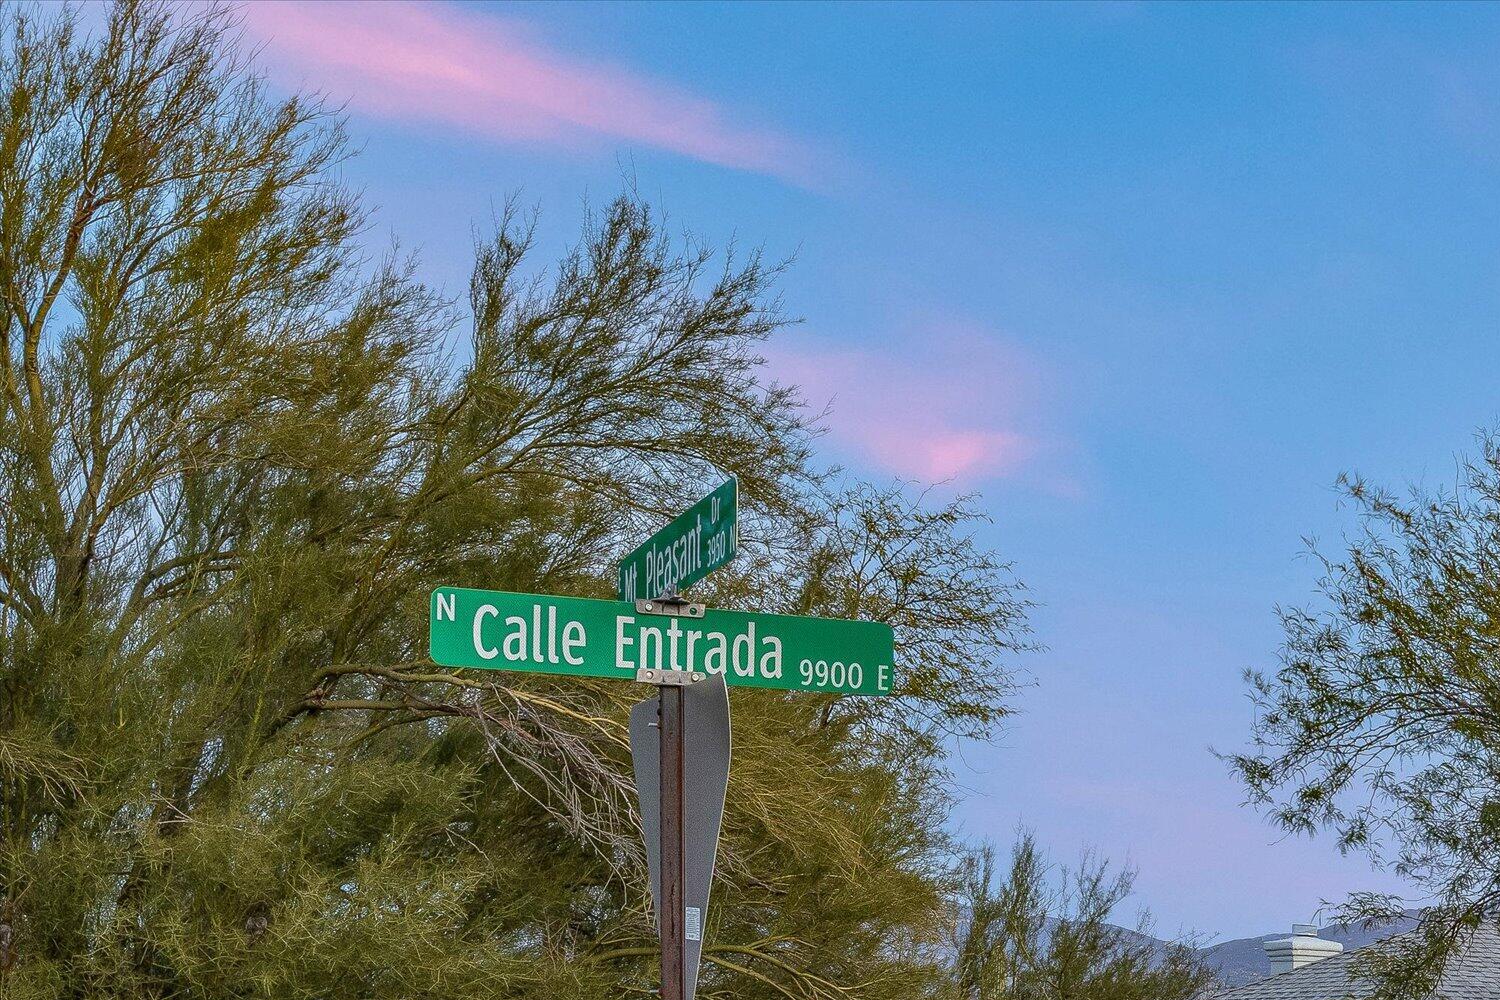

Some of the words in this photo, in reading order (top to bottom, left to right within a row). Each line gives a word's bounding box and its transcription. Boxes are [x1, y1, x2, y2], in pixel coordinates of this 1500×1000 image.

[624, 561, 638, 601] Mt
[646, 513, 702, 600] Pleasant
[711, 496, 721, 525] Dr
[707, 530, 726, 567] 3950
[729, 523, 736, 554] N
[436, 592, 456, 621] N
[473, 604, 587, 665] Calle
[615, 615, 783, 679] Entrada
[799, 659, 863, 689] 9900
[877, 664, 889, 691] E
